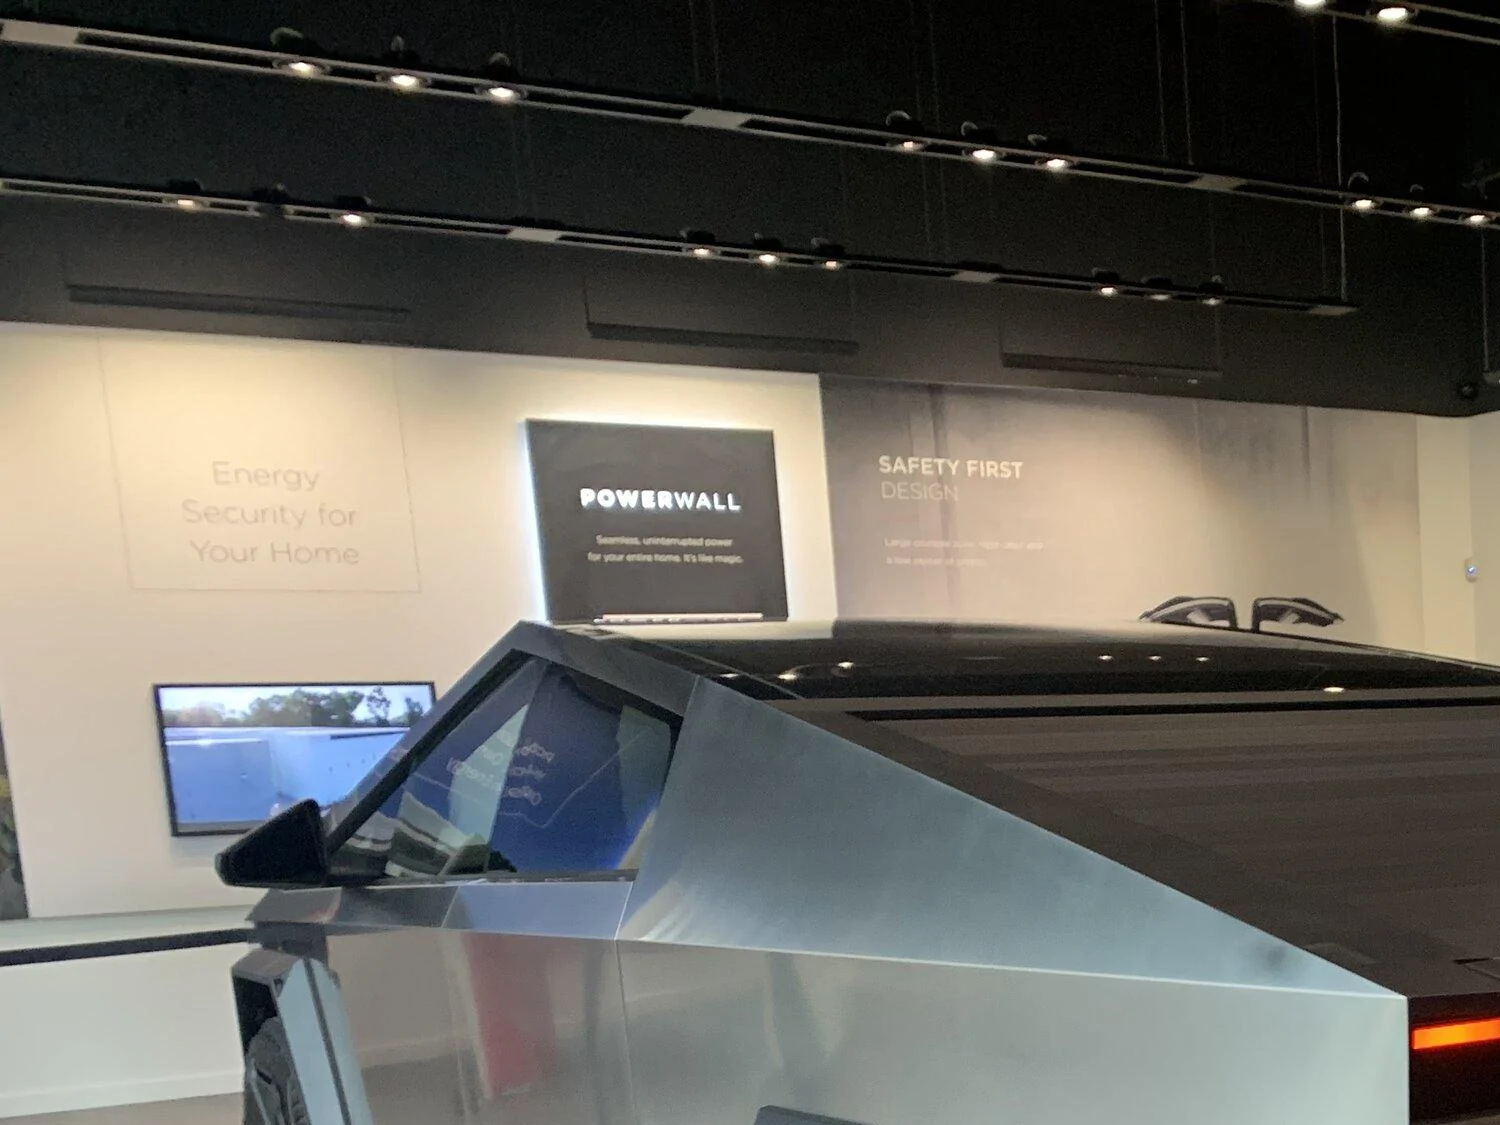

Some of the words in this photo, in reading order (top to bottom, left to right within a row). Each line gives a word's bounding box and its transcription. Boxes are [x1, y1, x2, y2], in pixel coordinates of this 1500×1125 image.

[212, 460, 320, 491] Energy
[878, 455, 960, 475] SAFETY
[966, 460, 1023, 478] FIRST
[579, 487, 742, 512] POWERWALL
[881, 481, 959, 503] DESIGN
[181, 498, 306, 529] Security
[318, 502, 356, 527] for
[189, 539, 259, 563] Your
[270, 541, 360, 565] Home
